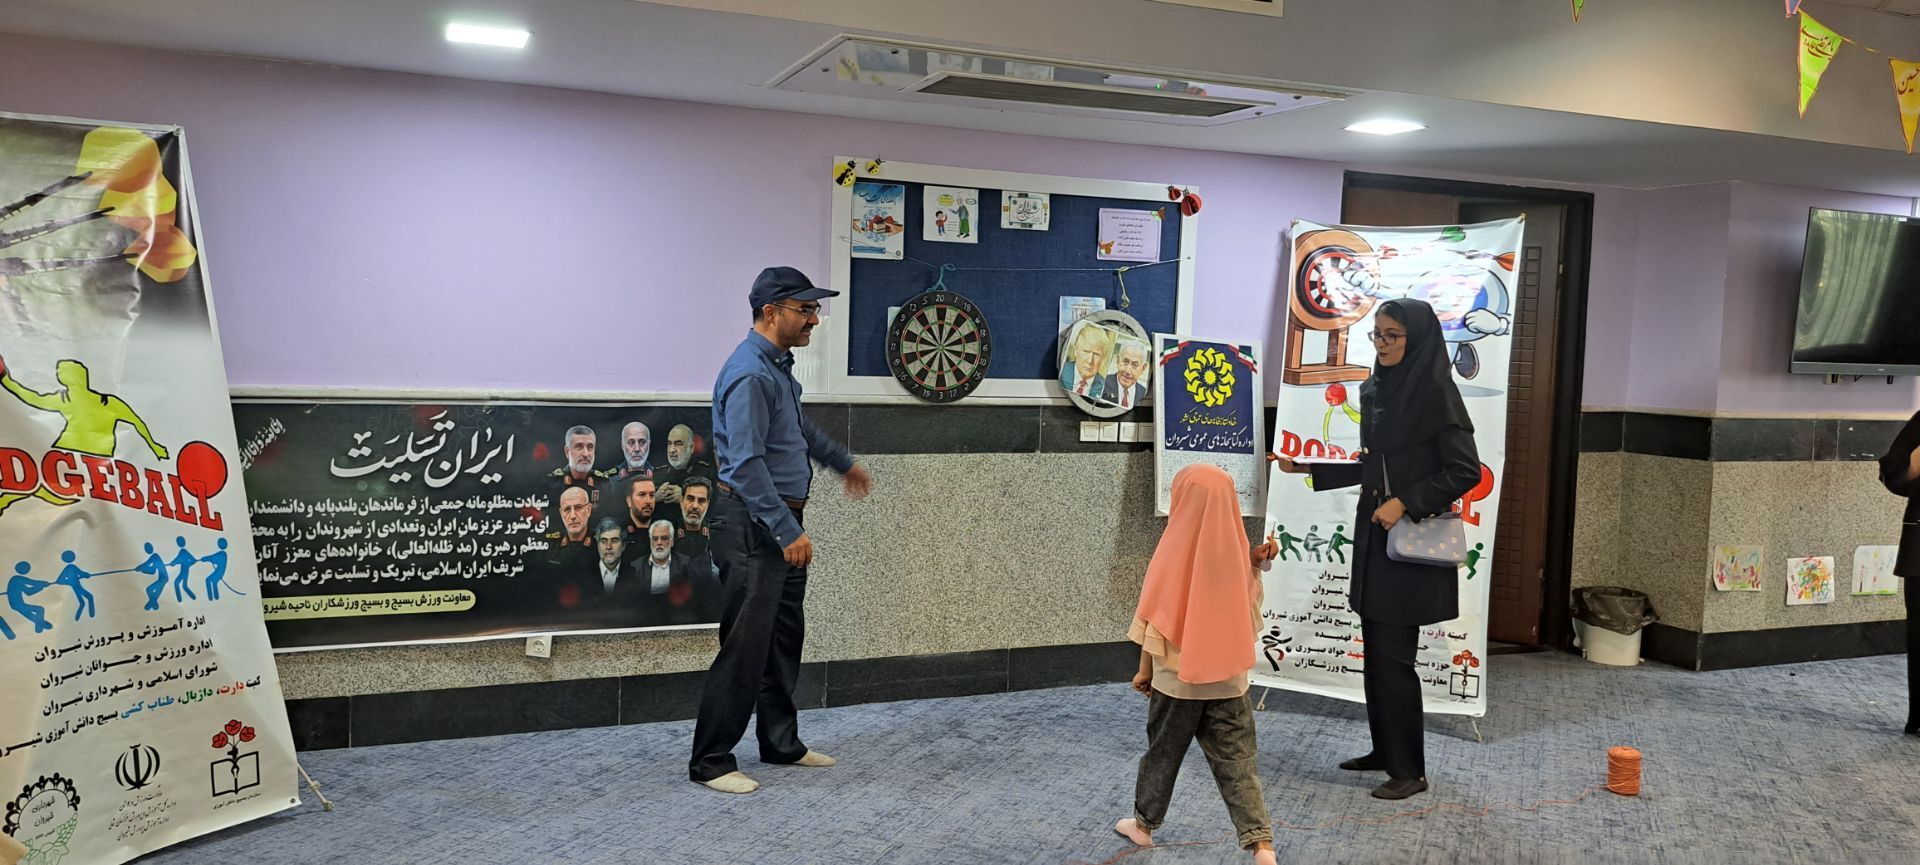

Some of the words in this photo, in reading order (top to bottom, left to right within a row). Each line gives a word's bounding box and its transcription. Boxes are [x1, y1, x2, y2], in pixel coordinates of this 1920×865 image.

[910, 304, 916, 312] 12
[964, 303, 971, 312] 18
[900, 314, 906, 322] 9
[980, 329, 986, 337] 13
[894, 358, 900, 366] 8
[980, 358, 986, 366] 10
[899, 372, 908, 380] 16
[973, 371, 981, 380] 15
[939, 392, 944, 400] 3
[950, 390, 957, 398] 17
[1165, 425, 1192, 450] شیروان
[315, 497, 357, 517] بلندپایه
[359, 496, 417, 515] فرماندهان
[418, 496, 429, 514] از
[430, 497, 464, 513] جمعی
[466, 494, 513, 513] مظلومانه
[514, 494, 549, 511] شهادت
[306, 504, 313, 517] و
[291, 522, 302, 542] را
[305, 520, 363, 539] شهروندان
[365, 520, 375, 538] از
[427, 517, 456, 536] ایران
[505, 515, 531, 534] کشور
[277, 526, 289, 540] به
[480, 541, 517, 556] رهبری
[520, 537, 549, 555] معظم
[283, 547, 311, 562] معزز
[301, 566, 333, 584] عرض
[334, 564, 371, 582] تسلیت
[381, 563, 415, 582] تبریک
[462, 560, 491, 579] ایران
[492, 559, 525, 577] شریف
[1318, 570, 1350, 581] شیروان
[371, 571, 379, 583] و
[1312, 585, 1344, 596] شیروان
[288, 600, 310, 612] ناحیه
[312, 597, 359, 612] ورزشکاران
[361, 599, 384, 612] بسیج
[384, 599, 390, 608] و
[391, 599, 414, 610] بسیج
[415, 594, 441, 607] ورزش
[443, 593, 471, 605] معاونت
[1313, 600, 1345, 611] شیروان
[187, 614, 206, 630] اداره
[1262, 609, 1288, 620] شیروان
[1289, 612, 1312, 622] آموزی
[1313, 615, 1333, 625] دانش
[137, 618, 183, 639] آموزش
[1334, 618, 1352, 628] بسیج
[84, 632, 124, 650] پرورش
[128, 631, 134, 641] و
[1315, 632, 1352, 643] فهمیده
[1447, 632, 1468, 641] کمیته
[35, 638, 82, 662] شیروان
[189, 638, 213, 653] اداره
[1295, 644, 1327, 653] صبوری
[1327, 647, 1345, 658] جواد
[145, 653, 151, 663] و
[154, 646, 186, 661] ورزش
[85, 654, 141, 676] جوانان
[185, 661, 218, 680] شورای
[1294, 658, 1340, 672] ورزشکاران
[1431, 661, 1450, 671] حوزه
[41, 665, 83, 688] شیروان
[146, 668, 182, 688] اسلامی
[1422, 675, 1448, 686] معاونت
[86, 678, 134, 702] شهرداری
[137, 680, 143, 690] و
[43, 691, 83, 716] شیروان
[121, 701, 144, 719] کشی
[147, 695, 174, 711] طناب
[72, 715, 94, 734] دانش
[97, 710, 118, 725] بسیج
[45, 720, 70, 744] آموزی
